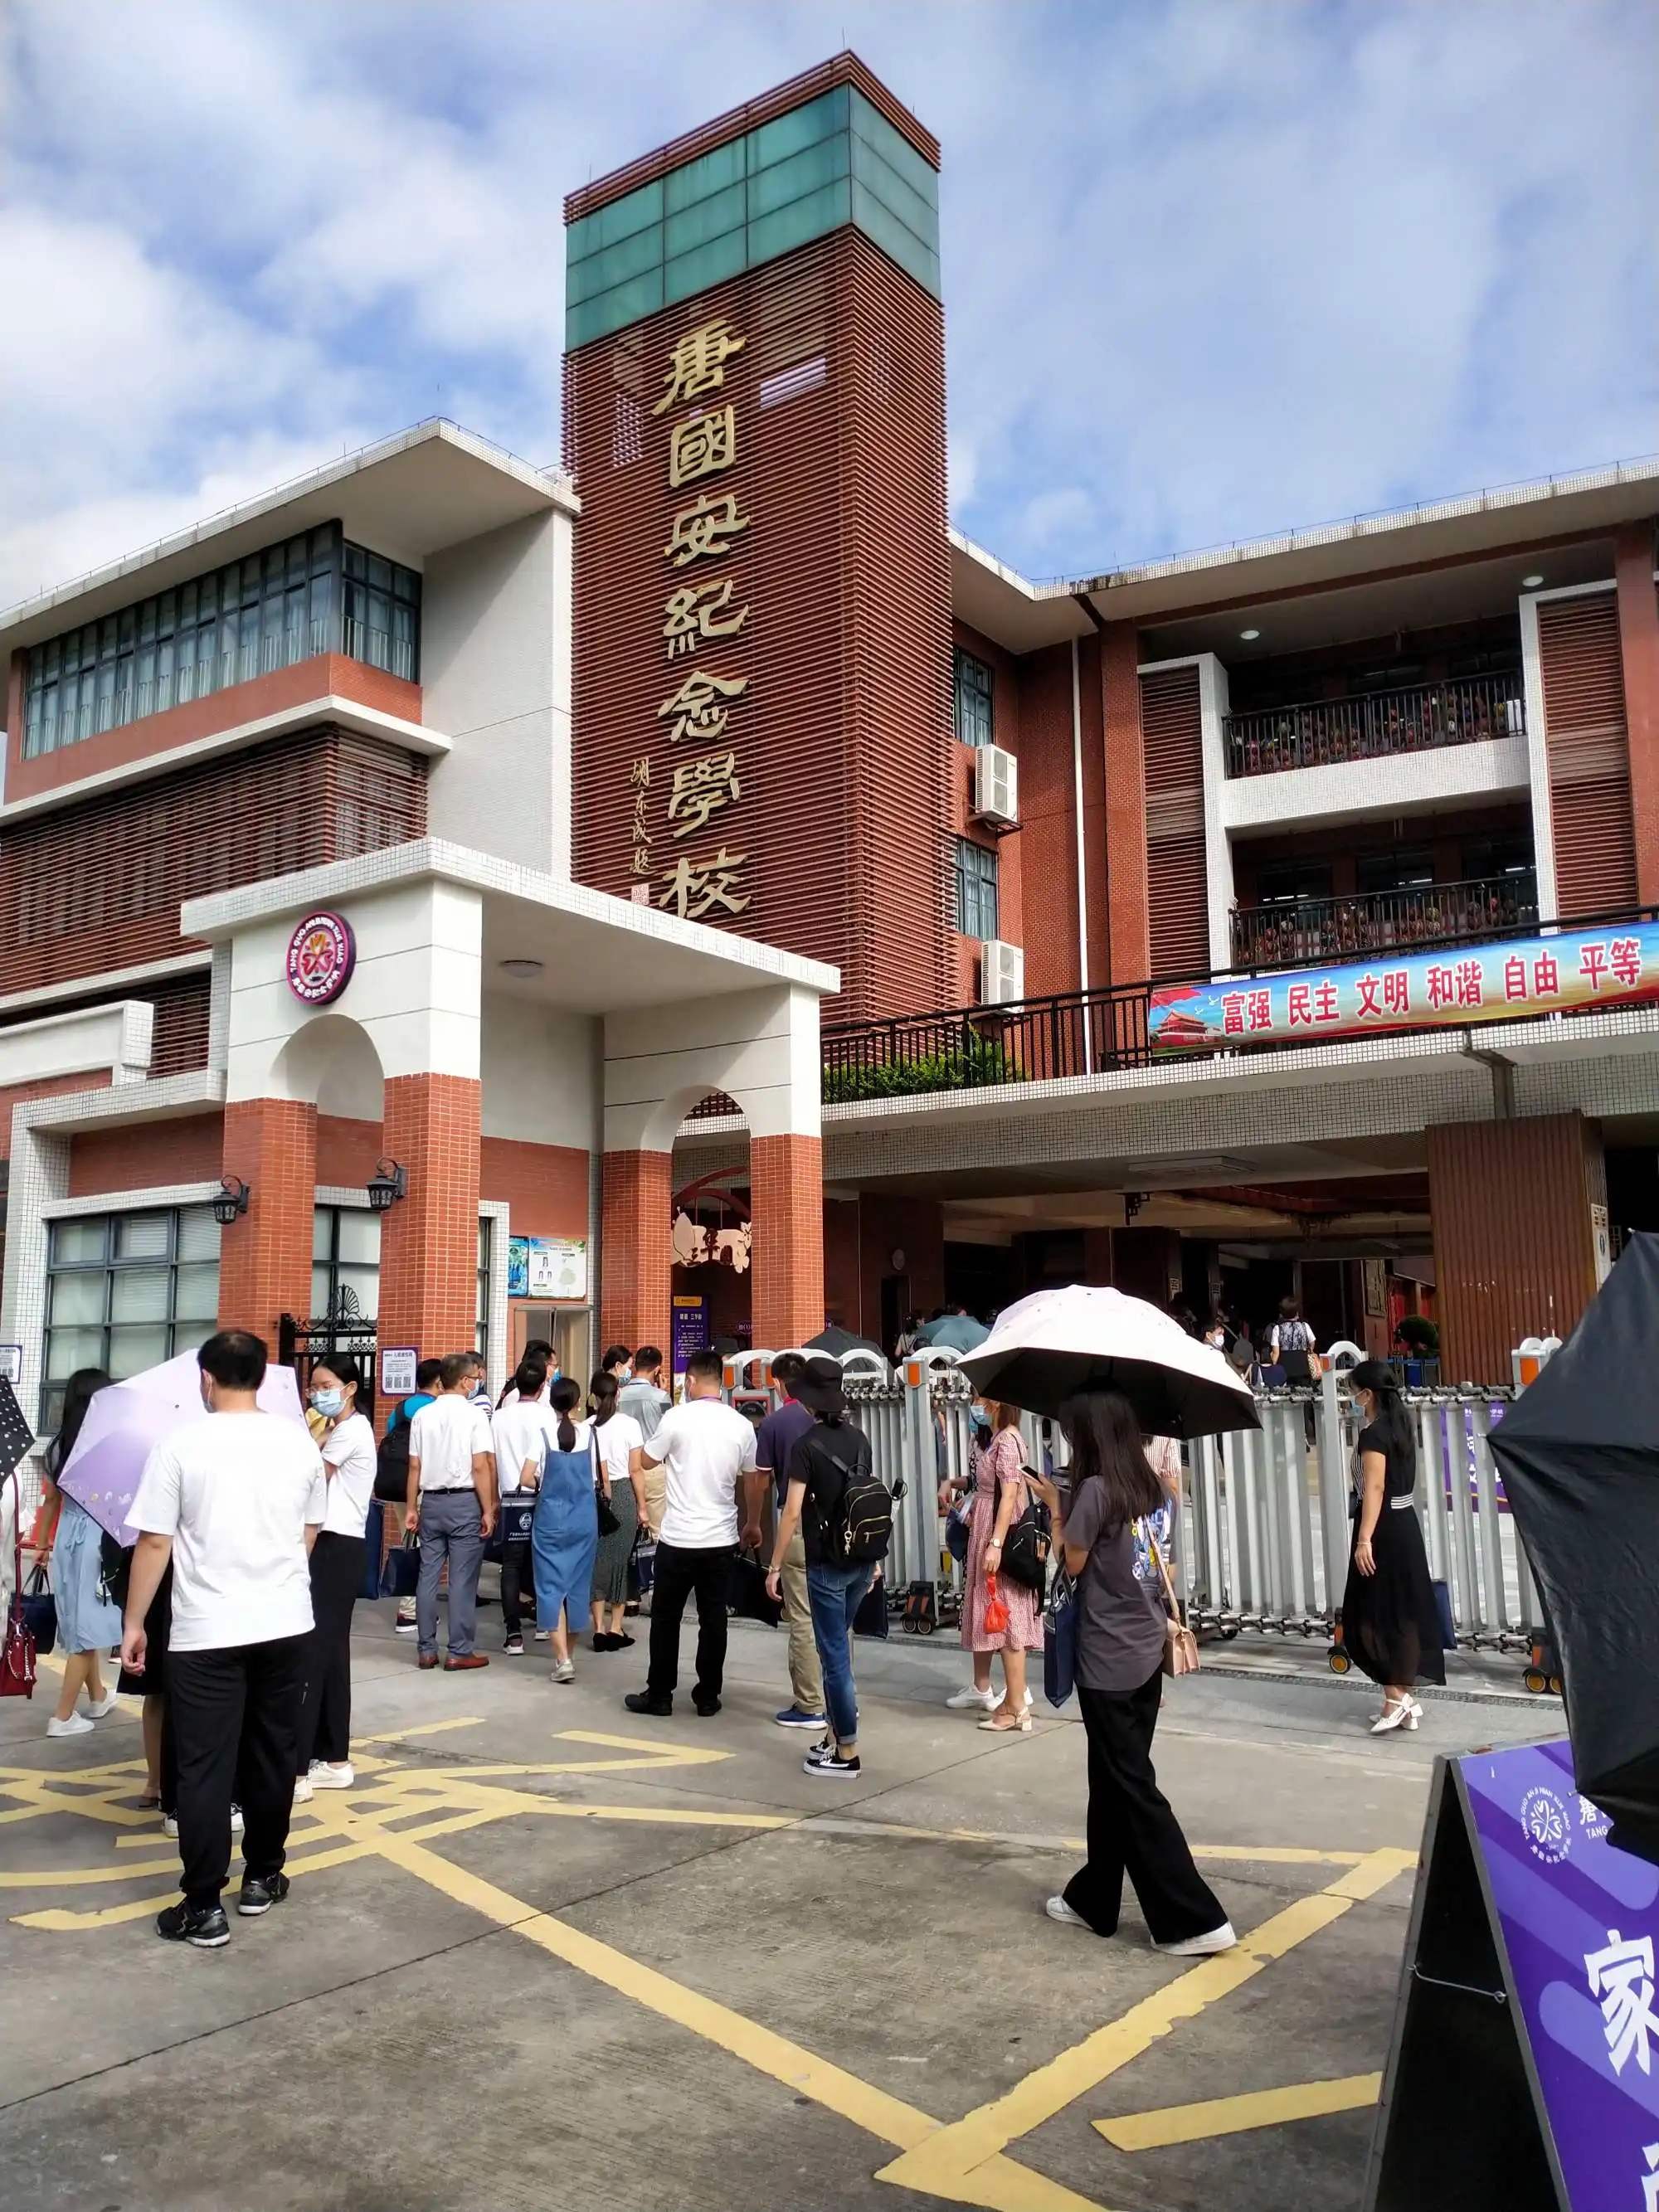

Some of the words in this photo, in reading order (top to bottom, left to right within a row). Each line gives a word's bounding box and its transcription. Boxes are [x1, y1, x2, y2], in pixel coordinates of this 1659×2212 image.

[651, 320, 752, 918] 唐國安紀念學校
[1223, 990, 1272, 1034] 富强
[1289, 982, 1340, 1026] 民主
[1356, 971, 1410, 1018] 文明
[1427, 960, 1482, 1009] 和谐
[1504, 951, 1559, 1000] 自由
[1579, 939, 1641, 990] 平等
[1579, 1795, 1607, 1825] 唐
[1586, 1825, 1608, 1840] TANG
[1583, 1929, 1659, 2077] 家
